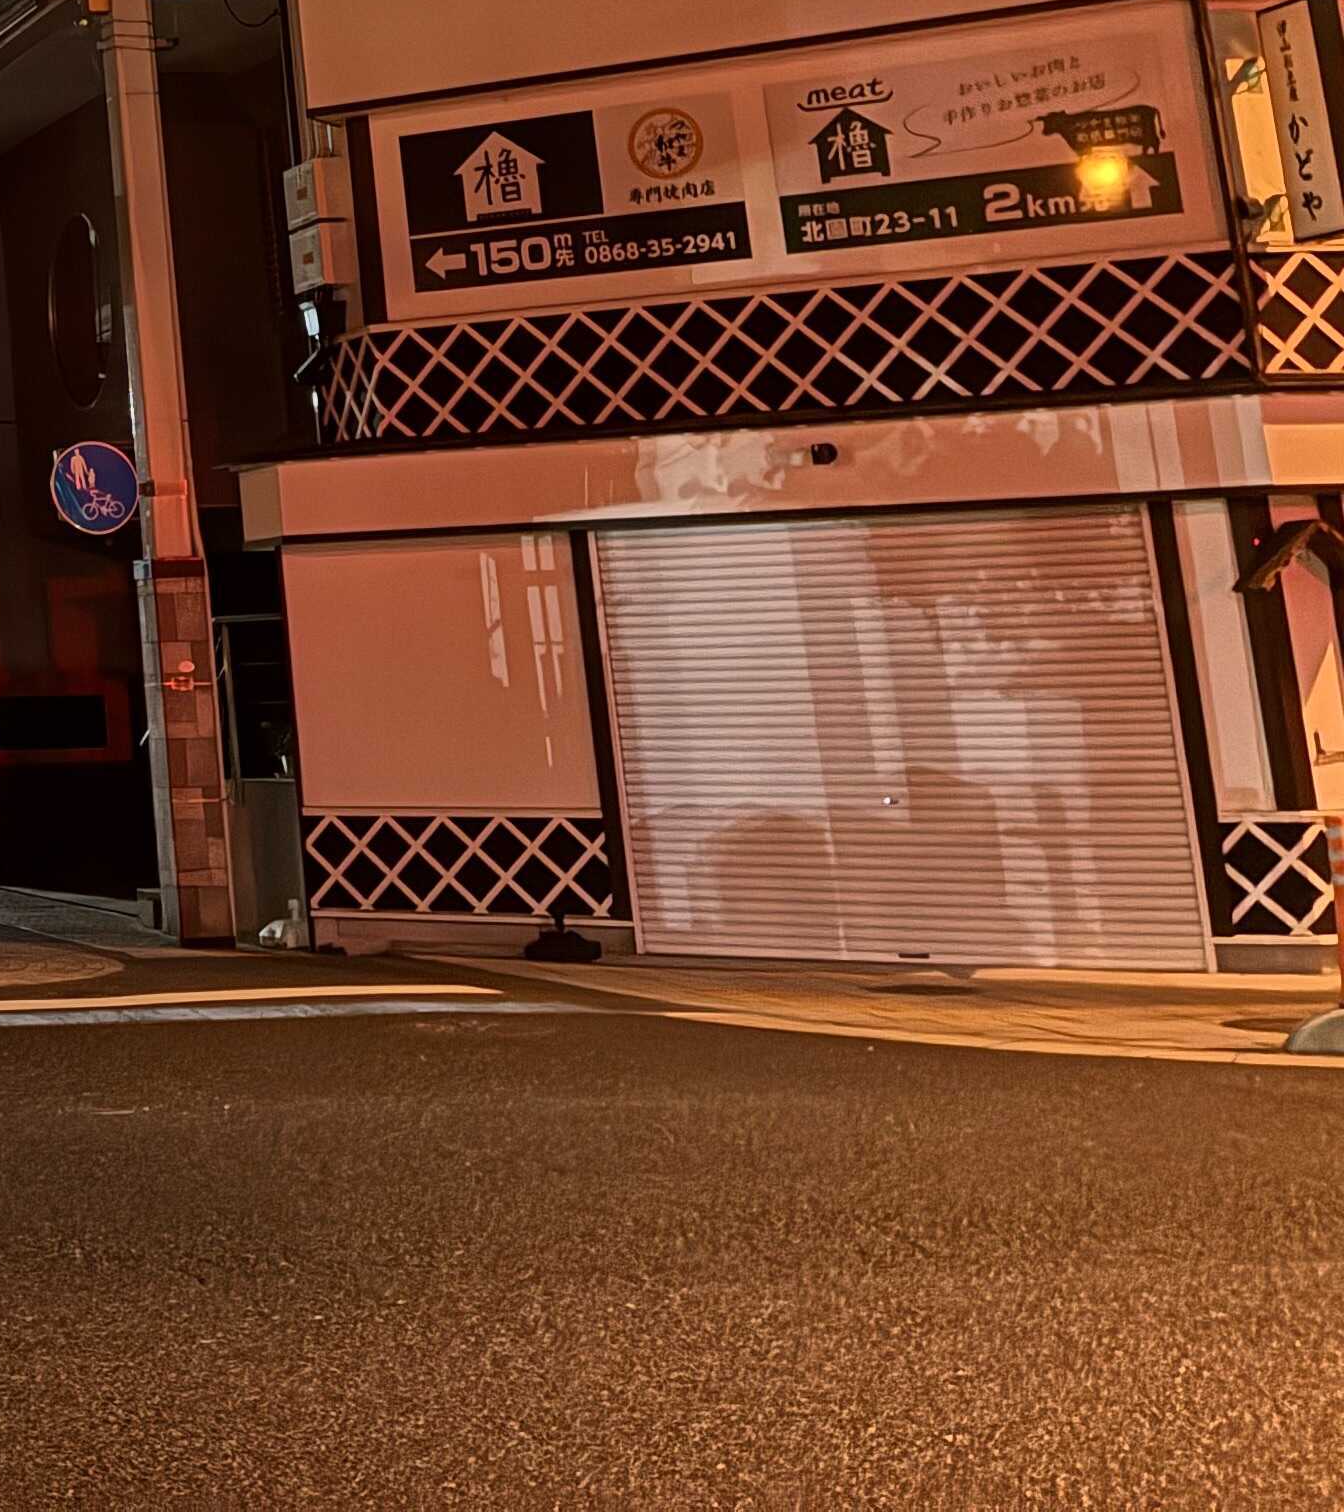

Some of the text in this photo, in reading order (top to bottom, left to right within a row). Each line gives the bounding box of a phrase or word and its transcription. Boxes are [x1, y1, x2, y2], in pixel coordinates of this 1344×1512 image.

[805, 77, 885, 107] meat
[1288, 113, 1323, 223] かどや
[582, 230, 610, 245] TEL
[583, 230, 738, 266] 0868-35-2941
